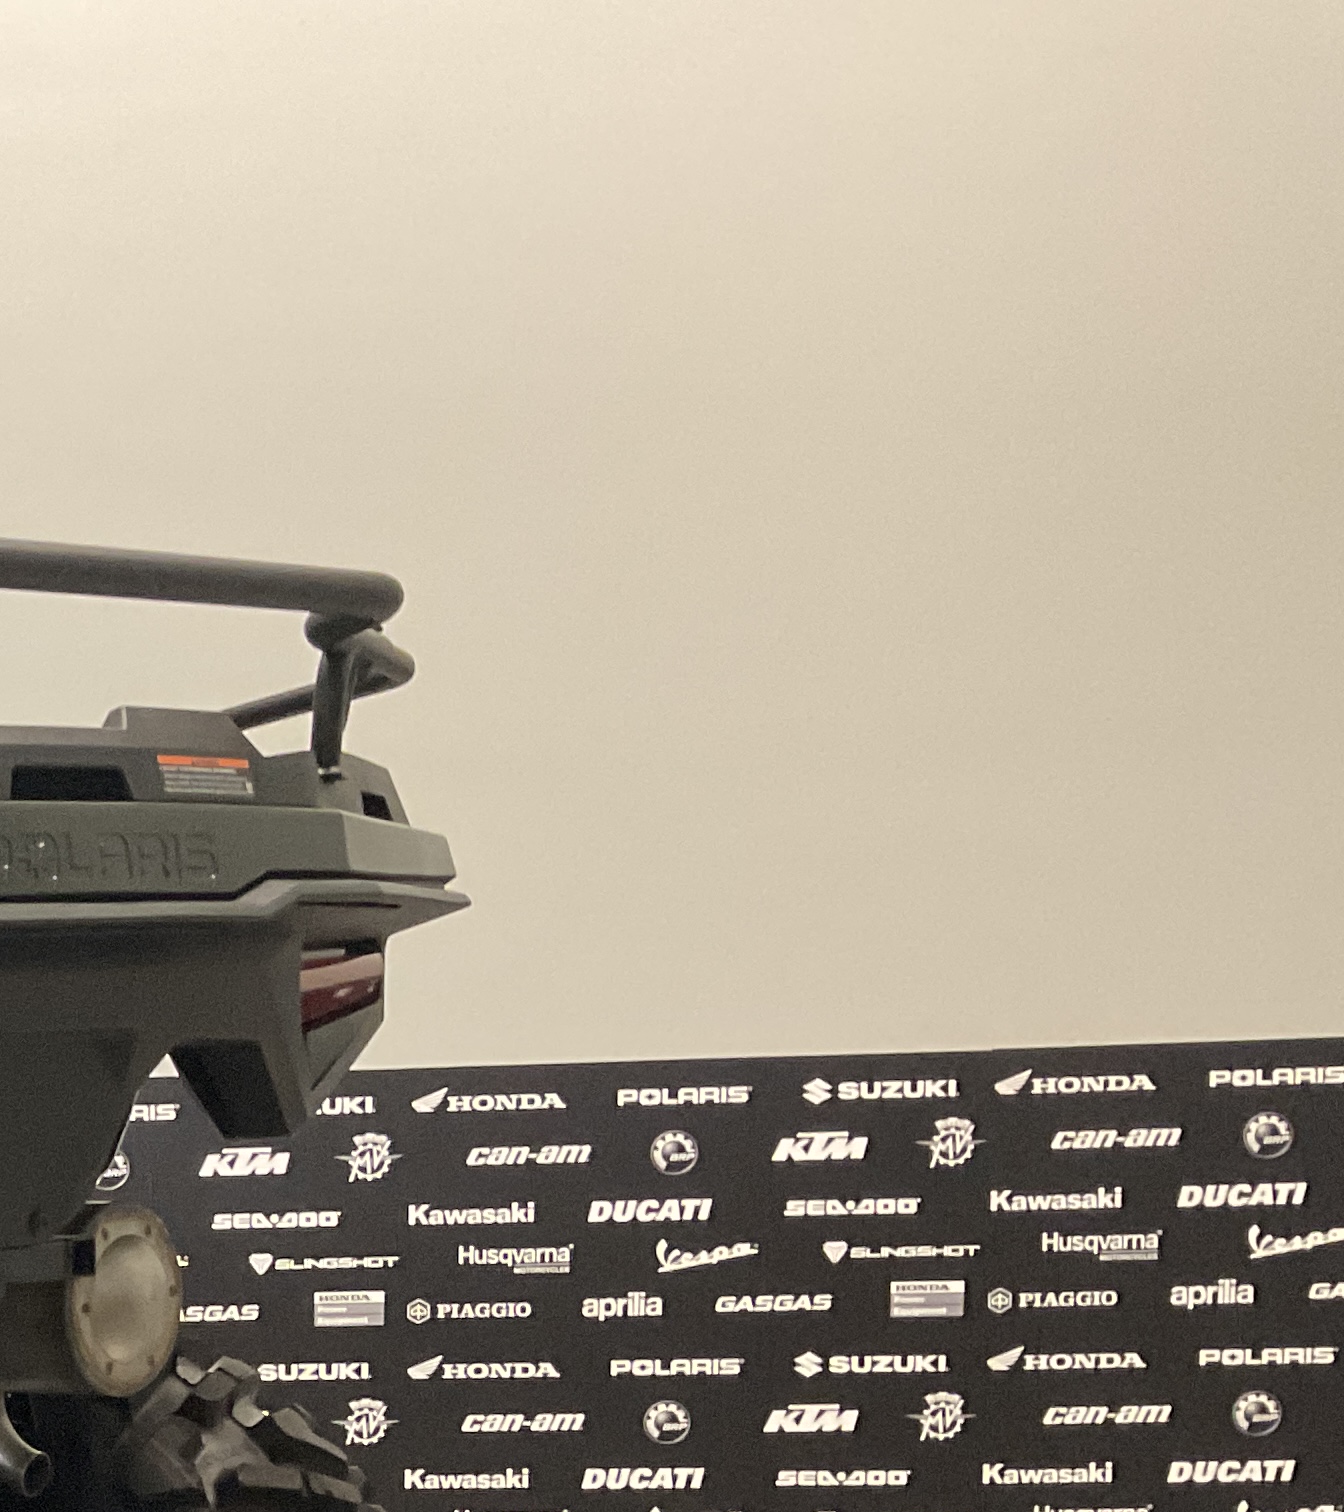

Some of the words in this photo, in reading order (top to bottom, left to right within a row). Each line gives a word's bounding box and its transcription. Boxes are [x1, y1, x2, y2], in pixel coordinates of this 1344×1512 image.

[838, 1079, 958, 1100] SUZUKI
[1031, 1075, 1156, 1094] HONDA
[316, 1096, 375, 1115] UKI
[447, 1093, 566, 1111] HONDA
[618, 1086, 752, 1106] POLARIS
[772, 1131, 868, 1161] KTM
[1051, 1128, 1181, 1149] can-am
[199, 1147, 290, 1177] KTM
[466, 1145, 591, 1165] can-am
[990, 1187, 1122, 1211] Kawasaki
[1177, 1182, 1307, 1207] DUCATI
[408, 1202, 534, 1225] Kawasaki
[588, 1199, 712, 1222] DUCATI
[850, 1245, 980, 1258] SLINGSHOT
[1041, 1231, 1159, 1255] Husqvarna
[275, 1256, 399, 1270] SLINGSHOT
[457, 1244, 571, 1267] Husqvarna
[656, 1239, 758, 1272] Vespa
[319, 1294, 370, 1302] HONDA
[896, 1284, 950, 1292] HONDA
[1170, 1279, 1254, 1309] aprilia
[582, 1292, 662, 1321] aprilia
[715, 1294, 832, 1312] GASGAS
[1019, 1291, 1117, 1307] PIAGGIO
[180, 1305, 259, 1322] SGAS
[437, 1302, 531, 1318] PIAGGIO
[829, 1355, 948, 1373] SUZUKI
[1024, 1353, 1146, 1370] HONDA
[1199, 1347, 1338, 1366] POLARIS
[258, 1363, 371, 1381] SUZUKI
[442, 1363, 560, 1378] HONDA
[611, 1359, 744, 1376] POLARIS
[461, 1414, 585, 1432] can-am
[763, 1404, 858, 1432] KTM
[1043, 1405, 1171, 1425] can-am
[404, 1468, 529, 1489] Kawasaki
[582, 1468, 704, 1489] DUCATI
[982, 1462, 1112, 1484] Kawasaki
[1167, 1460, 1295, 1483] DUCATI
